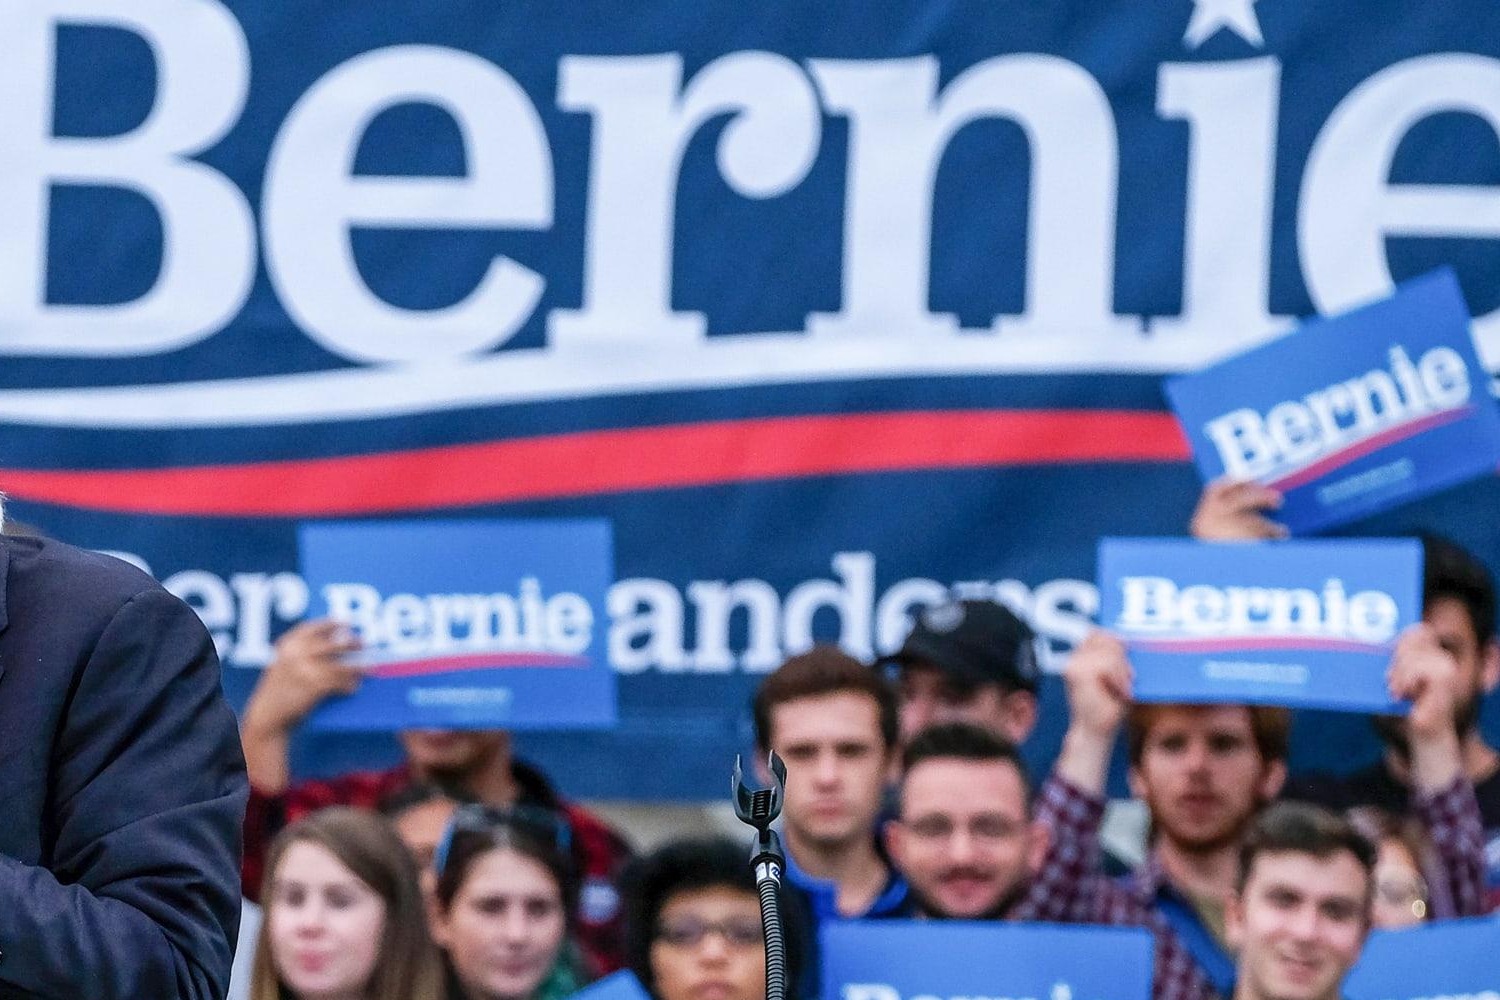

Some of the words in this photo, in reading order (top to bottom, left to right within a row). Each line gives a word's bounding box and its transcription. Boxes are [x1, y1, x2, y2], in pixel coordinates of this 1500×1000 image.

[1202, 343, 1472, 482] Bernie
[322, 576, 594, 656] Bernie
[1117, 575, 1399, 644] Bernie
